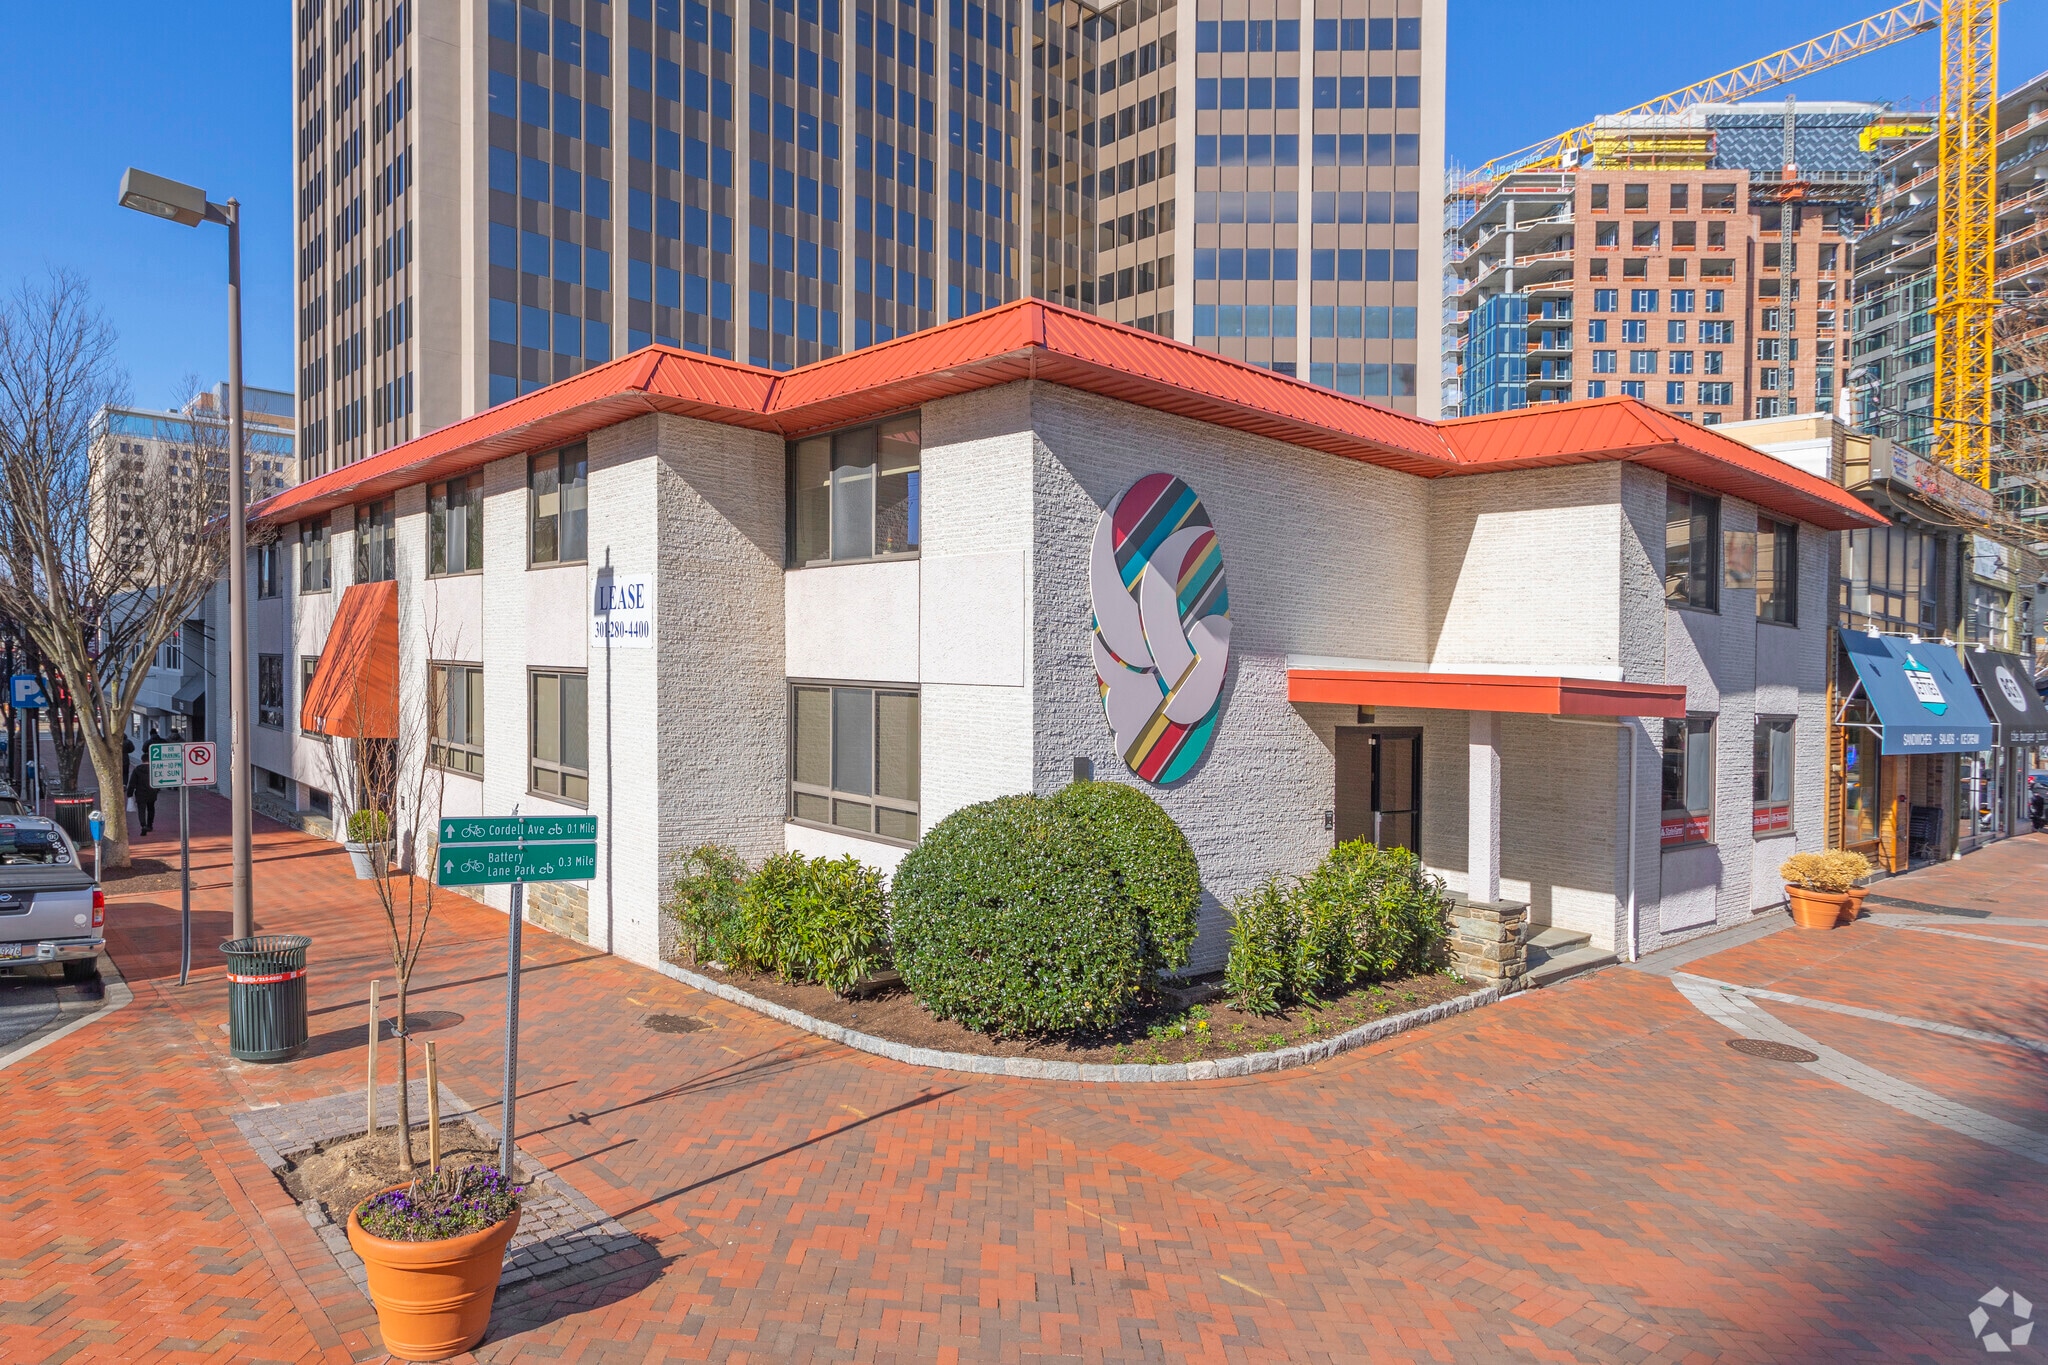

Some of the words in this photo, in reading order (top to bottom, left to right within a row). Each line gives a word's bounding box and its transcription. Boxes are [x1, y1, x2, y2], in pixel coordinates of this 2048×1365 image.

[600, 584, 644, 610] LEASE
[152, 748, 160, 759] 2
[489, 824, 524, 835] Cordell
[528, 824, 545, 835] Ave
[567, 823, 577, 834] 0.1
[579, 823, 595, 834] Mile
[488, 852, 524, 864] Battery
[488, 866, 510, 877] Lane
[514, 864, 535, 876] Park
[558, 857, 572, 867] 0.3
[575, 855, 594, 867] Mile
